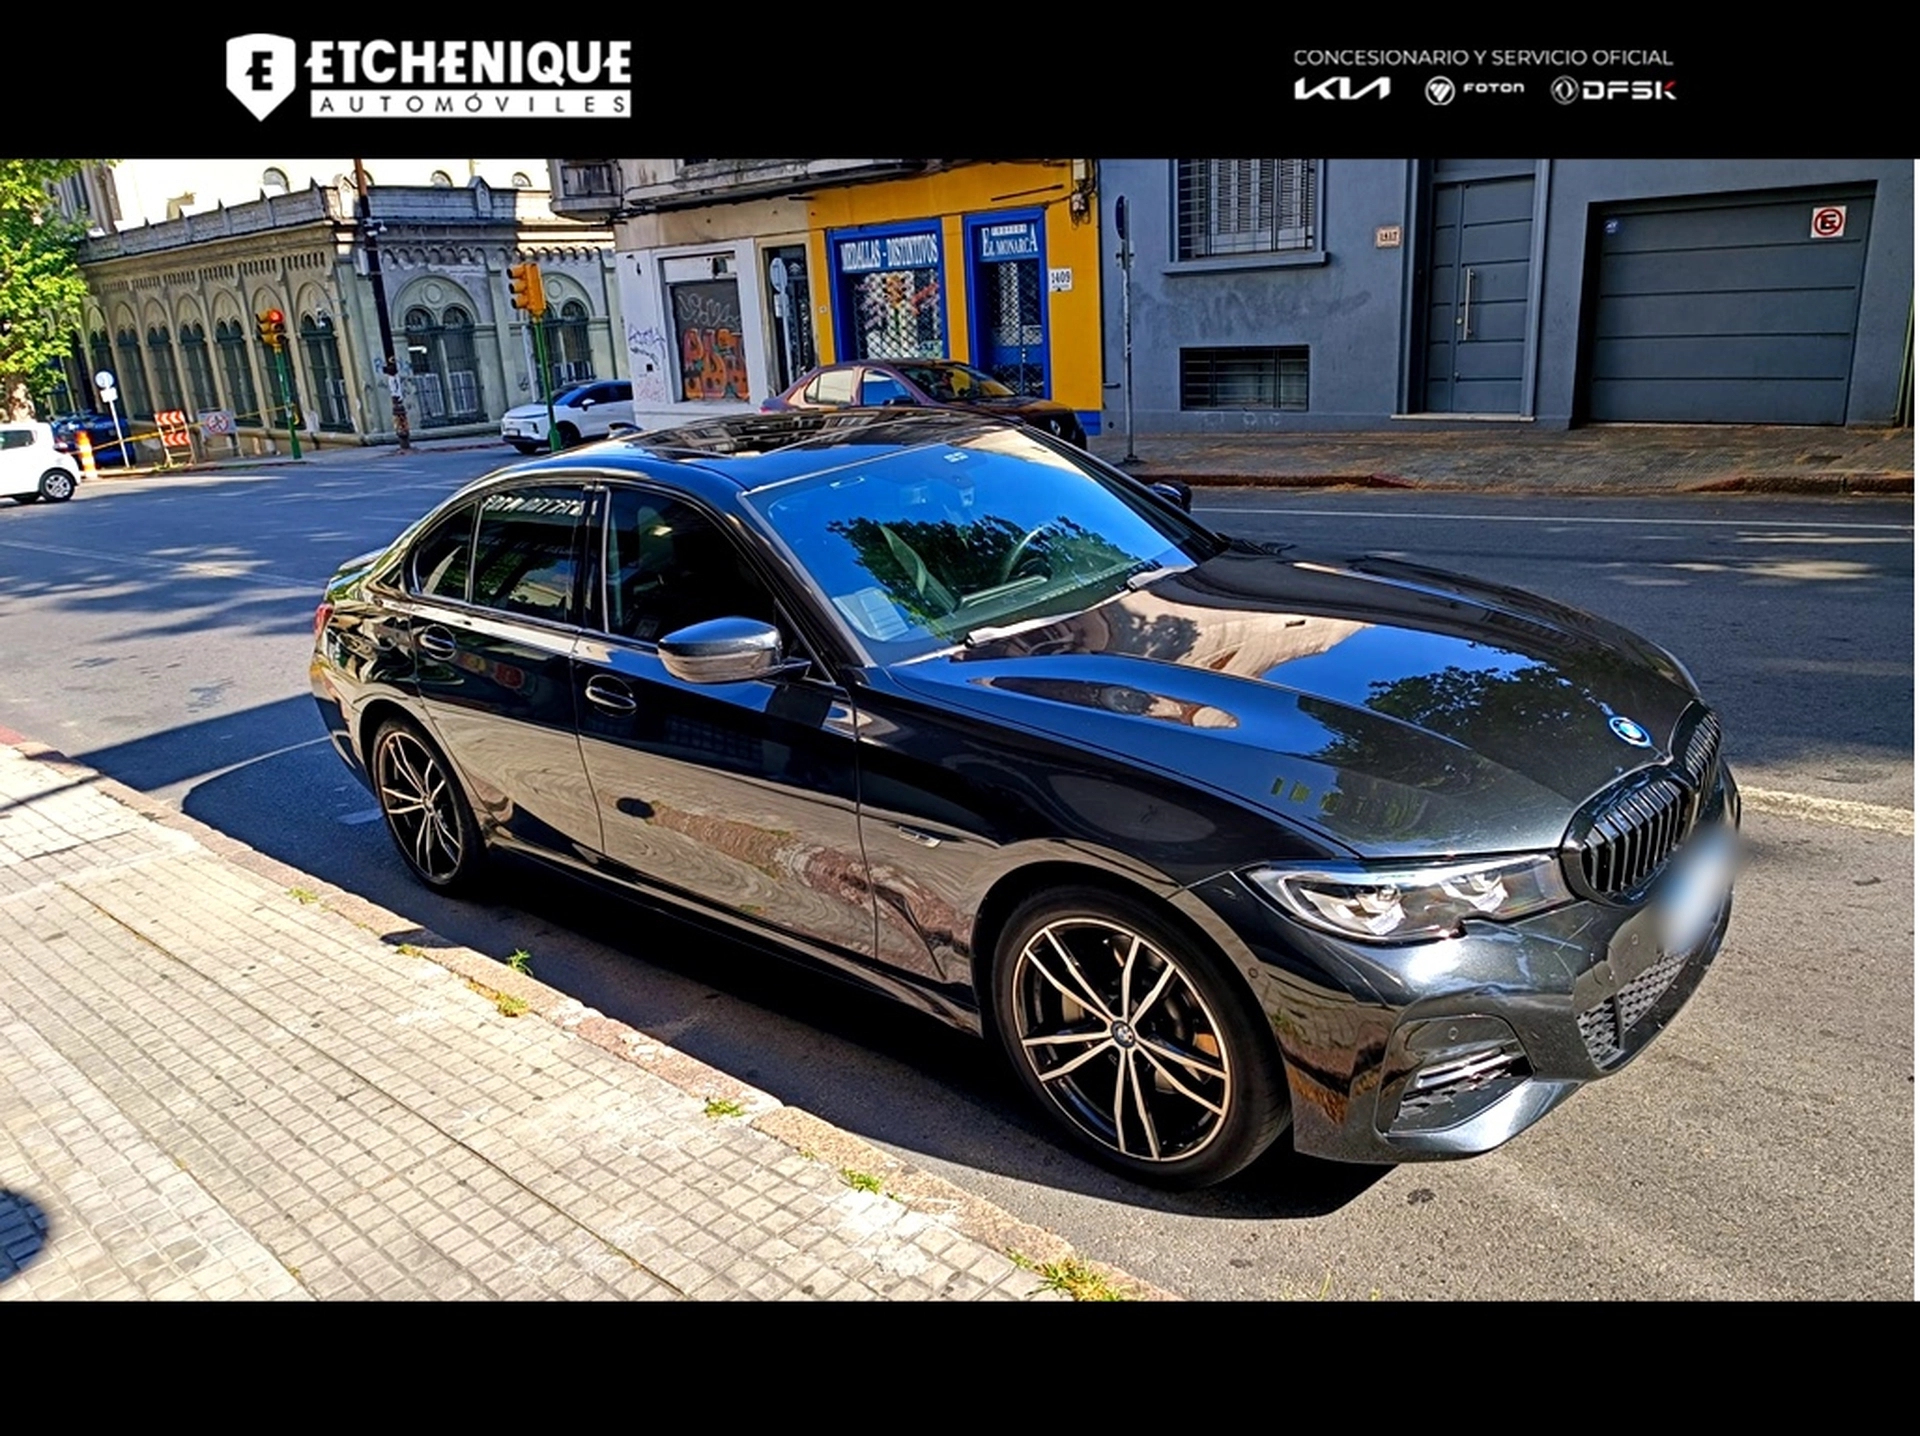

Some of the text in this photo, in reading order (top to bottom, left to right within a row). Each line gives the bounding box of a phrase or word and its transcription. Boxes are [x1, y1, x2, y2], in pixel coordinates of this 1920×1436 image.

[840, 239, 881, 271] MEDALLAS
[886, 233, 939, 267] DISTINTIVOS
[995, 223, 1039, 256] MONARCA
